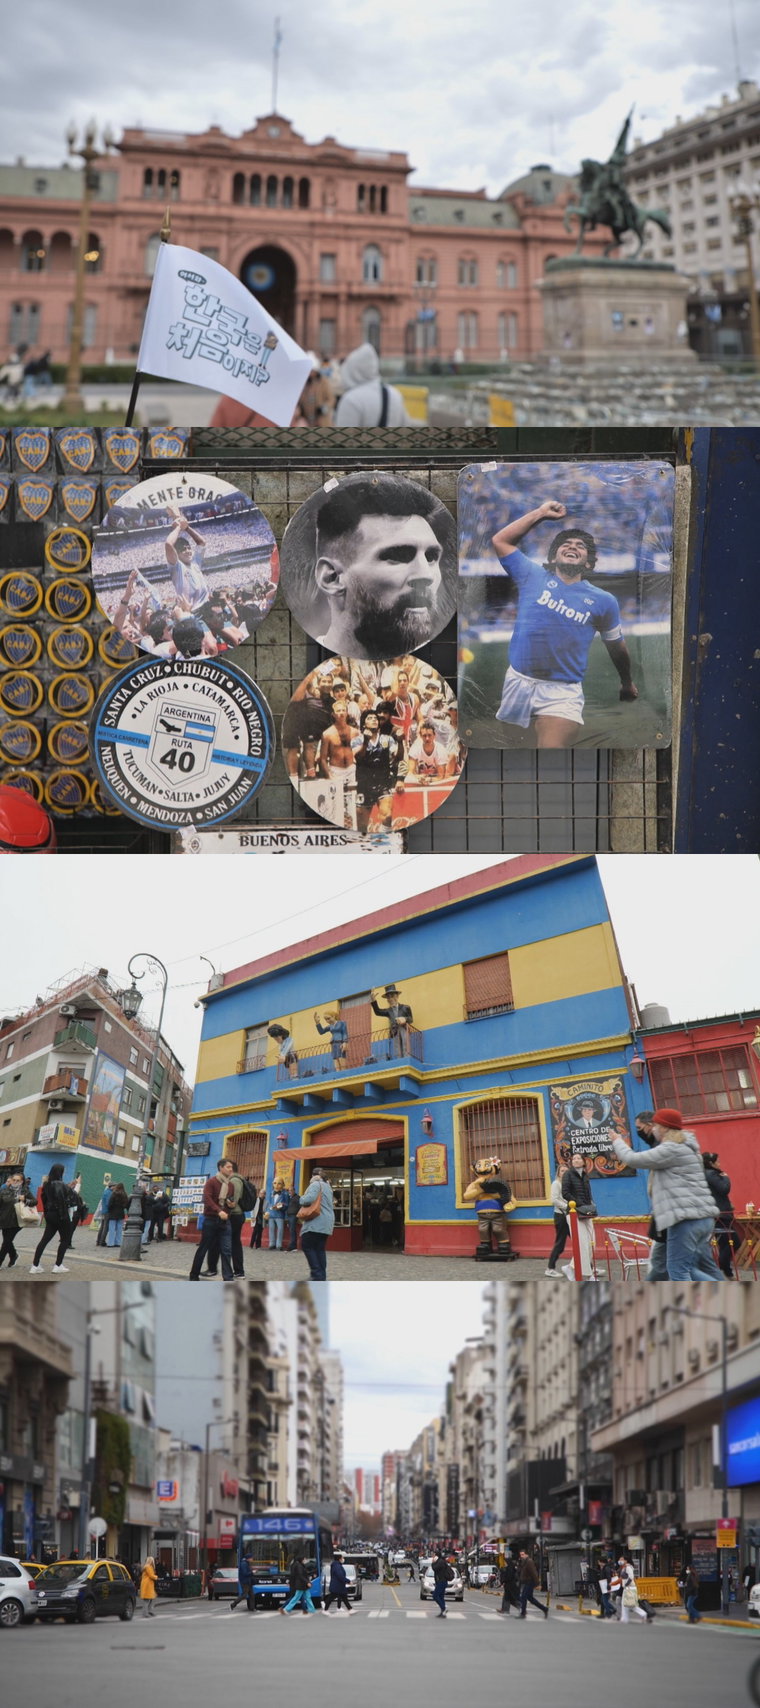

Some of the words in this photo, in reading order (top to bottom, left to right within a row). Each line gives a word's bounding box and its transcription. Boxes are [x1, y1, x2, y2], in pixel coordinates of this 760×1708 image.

[183, 284, 261, 356] 한국은
[166, 322, 270, 387] 처음이지?
[136, 486, 183, 510] MENTE
[536, 590, 591, 625] Buitoni
[104, 688, 132, 727] SANTA
[129, 665, 163, 689] CRUZ
[174, 662, 228, 685] CHUBUT
[232, 687, 252, 709] RIO
[246, 711, 263, 756] NEGRO
[133, 700, 148, 713] LA
[147, 681, 179, 701] RIOJA
[192, 682, 240, 732] CATAMARCA
[164, 706, 211, 723] ARGENTINA
[171, 738, 193, 749] RUTA
[160, 748, 195, 773] 40
[101, 746, 132, 799] NEUQUEN
[137, 800, 193, 823] MENDOZA
[204, 800, 228, 819] SAN
[228, 777, 253, 806] JUAN
[123, 749, 158, 795] TUCUMAN
[163, 789, 195, 803] SALTA
[203, 772, 231, 798] JUJUY
[239, 834, 299, 847] BUENOS
[304, 834, 348, 847] AIRES
[567, 1083, 604, 1096] CAMINITO
[571, 1128, 599, 1137] CENTRO
[601, 1126, 611, 1134] DE
[160, 1482, 171, 1496] E
[256, 1518, 302, 1532] 146
